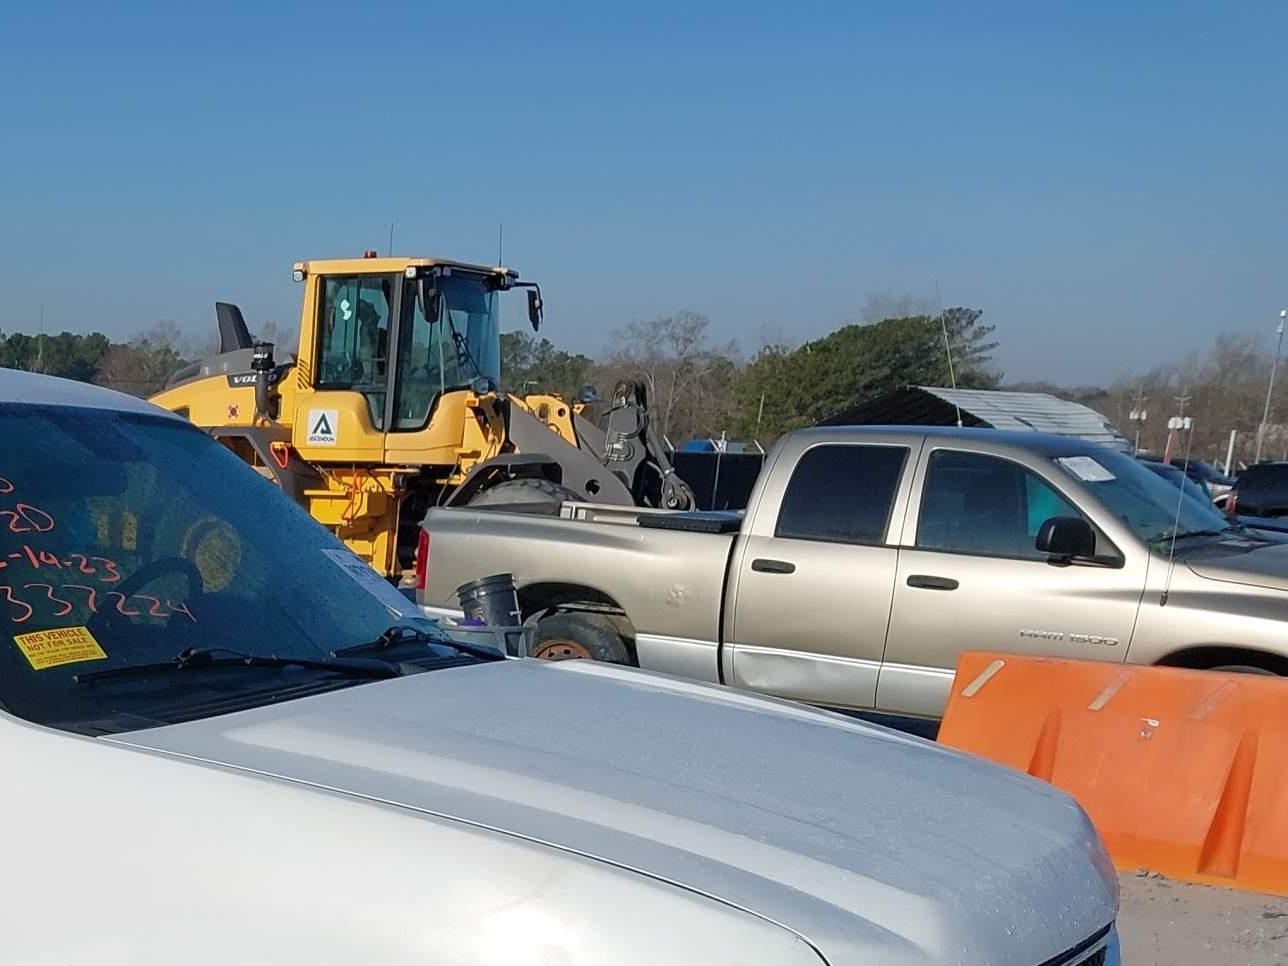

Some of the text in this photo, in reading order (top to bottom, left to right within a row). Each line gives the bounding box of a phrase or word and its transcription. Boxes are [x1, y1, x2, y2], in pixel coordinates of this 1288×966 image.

[232, 374, 278, 384] VOLO
[18, 628, 86, 646] THIS VEHICLE
[1069, 634, 1118, 646] 1500
[26, 637, 89, 652] NOT FOR SALE
